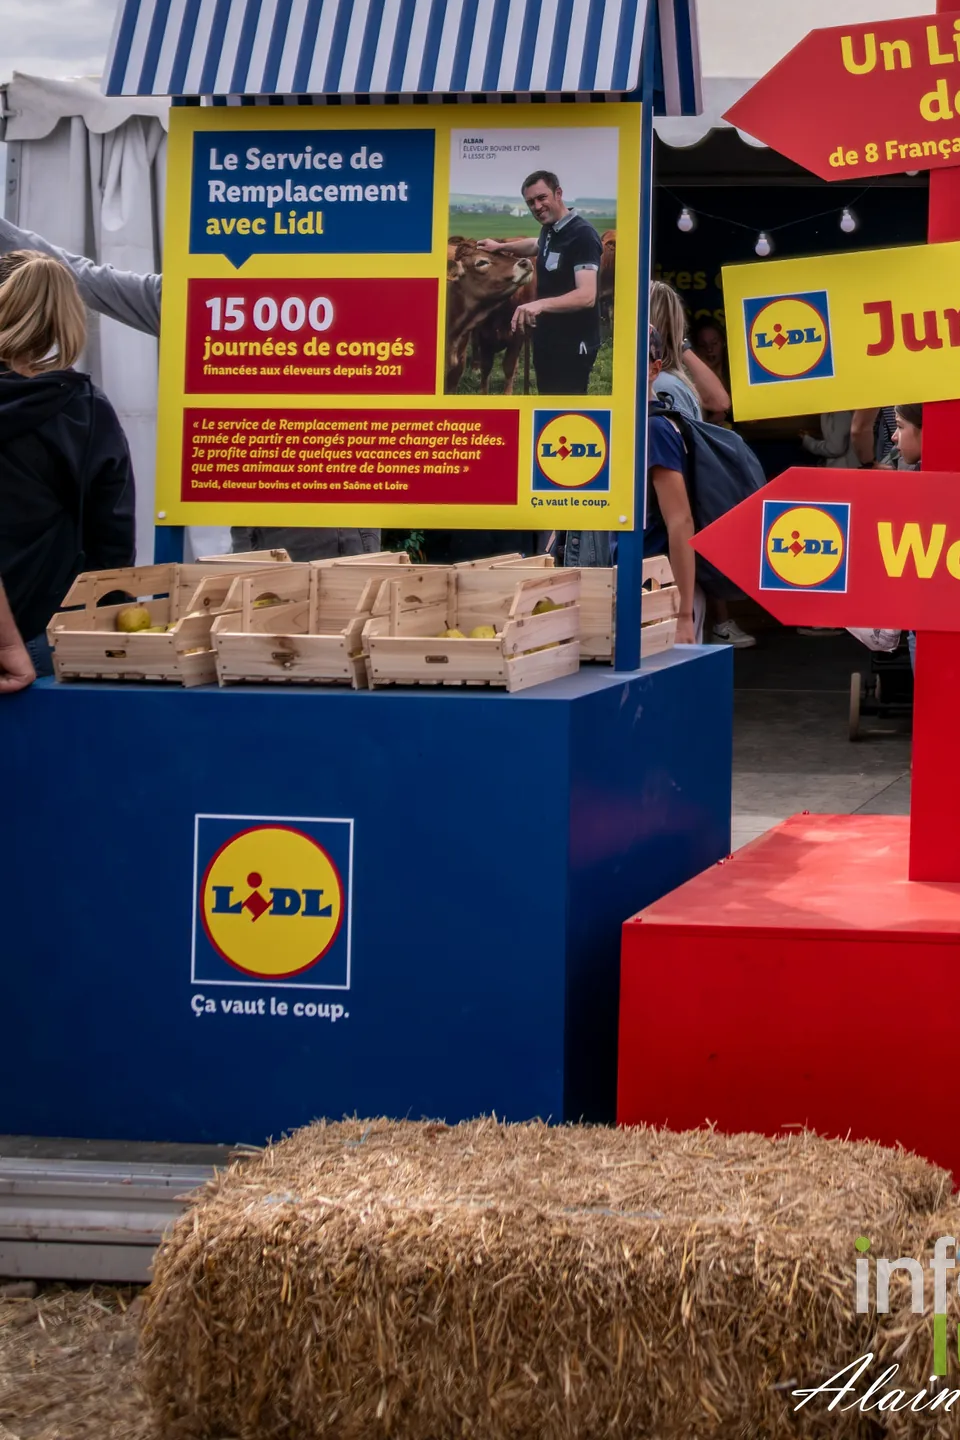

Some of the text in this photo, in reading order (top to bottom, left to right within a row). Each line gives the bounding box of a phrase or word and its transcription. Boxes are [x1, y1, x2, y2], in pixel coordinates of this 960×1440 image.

[841, 33, 912, 75] Un
[209, 145, 383, 170] Le Service de
[829, 146, 859, 167] de
[865, 142, 879, 163] 8
[208, 179, 408, 208] Remplacement
[206, 210, 324, 235] avec Lidl
[203, 336, 415, 361] journées de congés
[755, 323, 822, 351] LIDL
[203, 364, 402, 378] financées aux éleveurs depuis 2021
[202, 419, 481, 434] Le service de Remplacement me permet chaque
[541, 435, 602, 461] LIDL
[531, 497, 610, 508] Ça vaut le coup.
[771, 530, 839, 558] LIDL
[211, 871, 332, 923] LIDL
[191, 994, 349, 1022] Ça vaut le coup.
